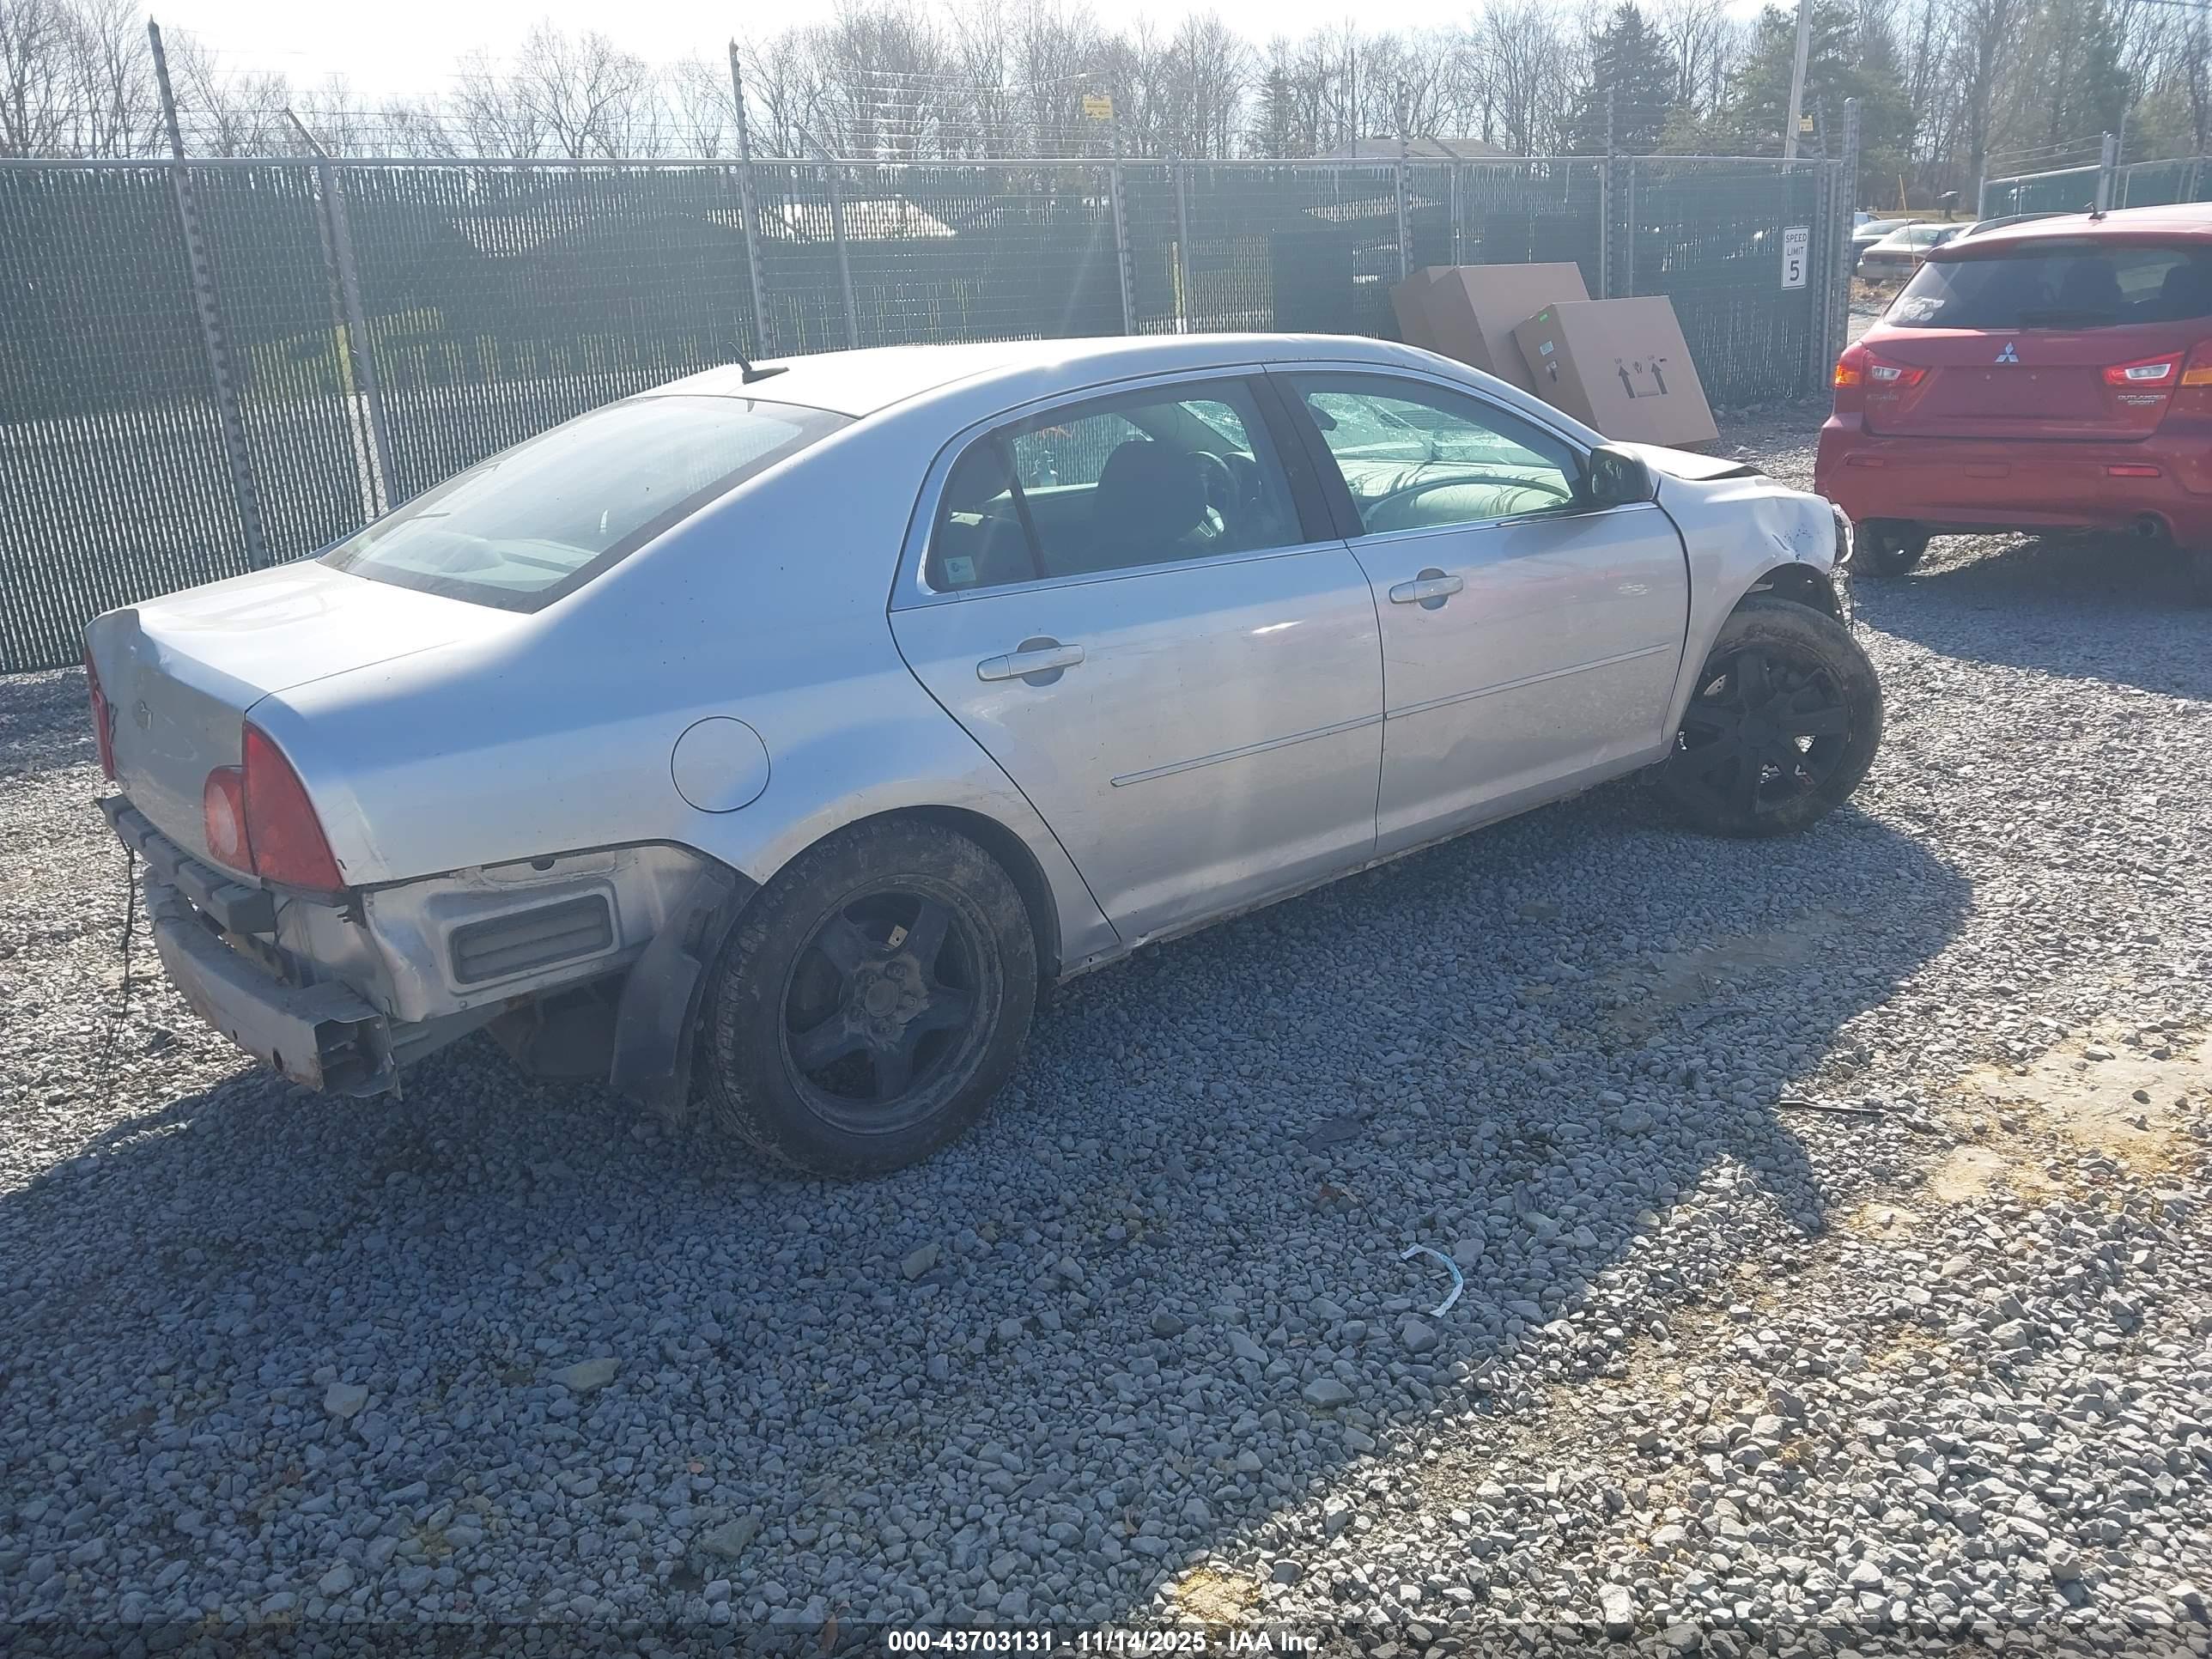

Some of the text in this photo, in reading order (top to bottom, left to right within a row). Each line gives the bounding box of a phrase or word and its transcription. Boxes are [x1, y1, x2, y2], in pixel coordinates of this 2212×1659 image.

[1785, 234, 1808, 243] SPEED
[1787, 246, 1804, 256] LIMIT
[1790, 260, 1800, 282] 5
